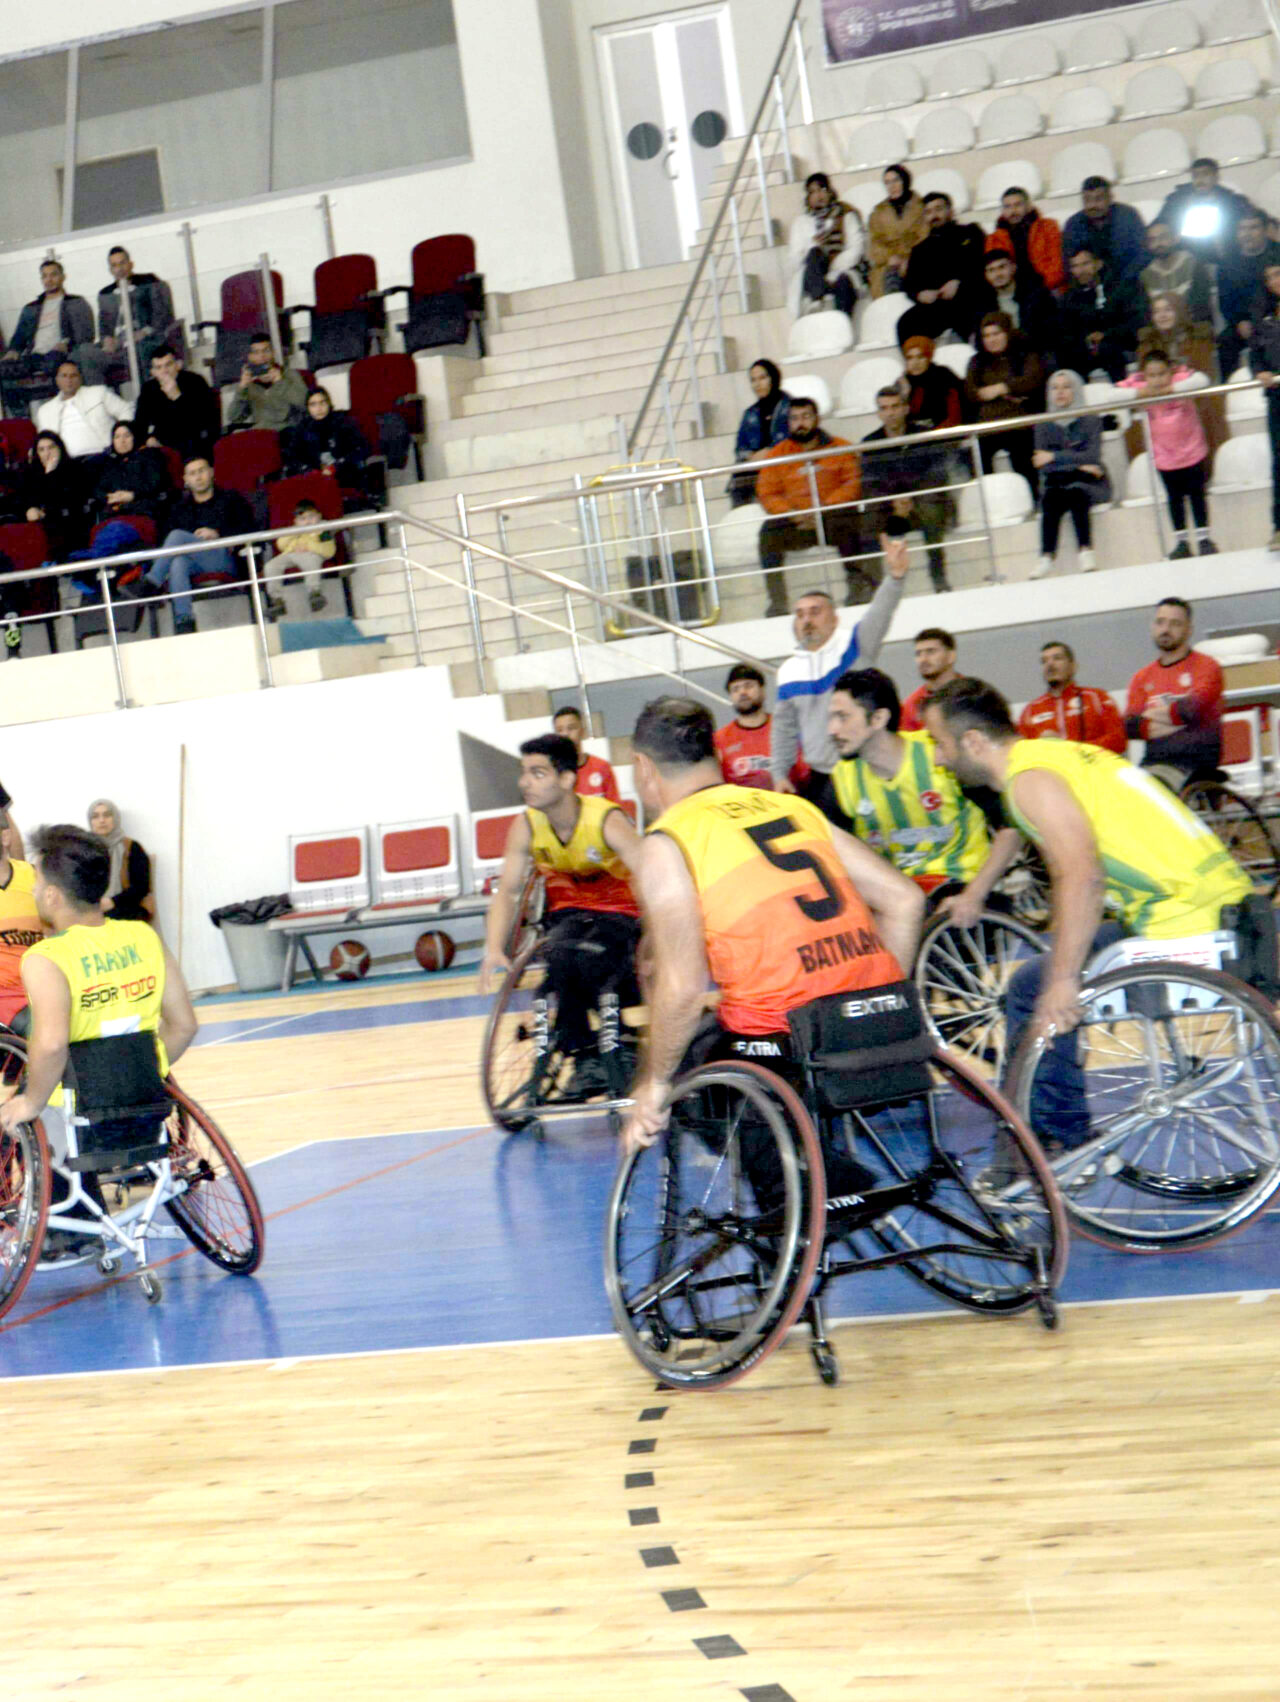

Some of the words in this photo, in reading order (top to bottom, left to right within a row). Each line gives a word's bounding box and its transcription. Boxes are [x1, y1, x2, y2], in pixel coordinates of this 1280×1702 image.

[744, 814, 845, 922] 5
[80, 986, 119, 1008] SPOR
[120, 975, 156, 998] TOTO
[842, 994, 910, 1018] EXTRA
